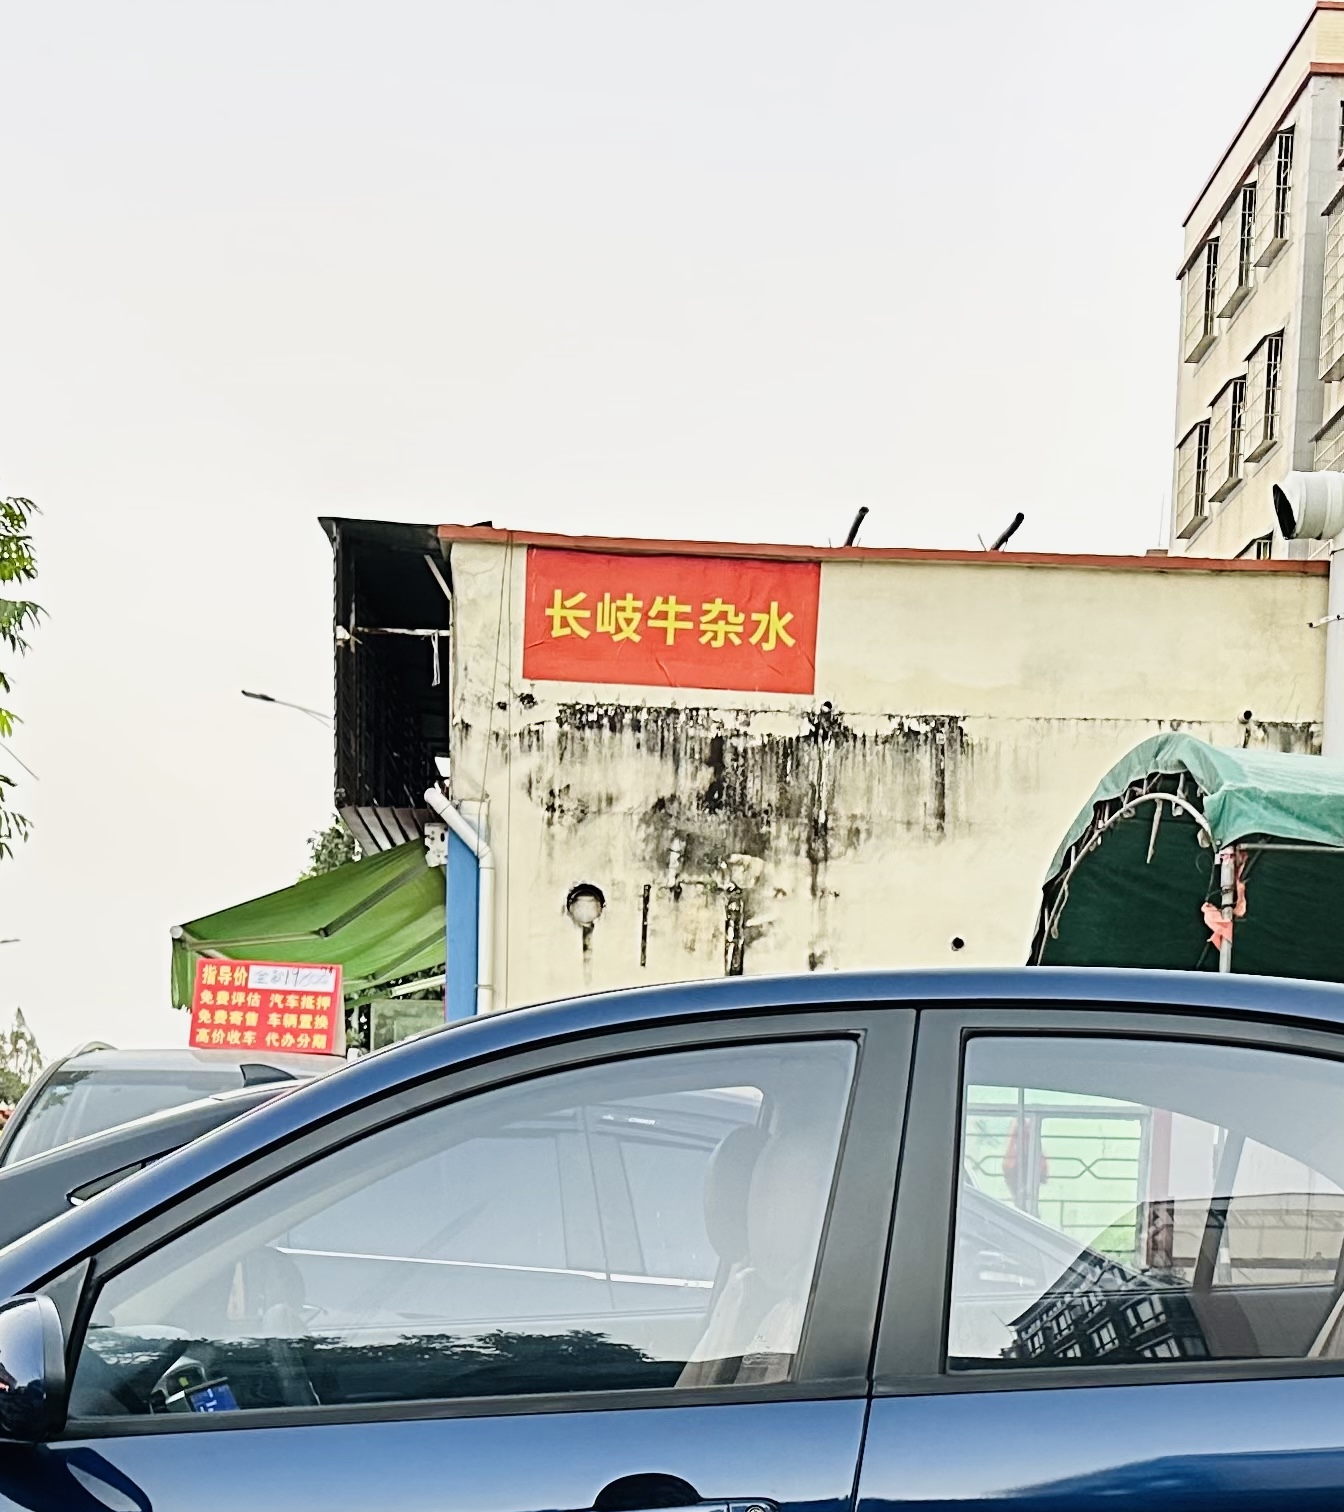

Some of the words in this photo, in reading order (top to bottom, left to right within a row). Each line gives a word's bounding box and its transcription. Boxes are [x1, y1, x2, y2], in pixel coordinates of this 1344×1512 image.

[545, 589, 796, 652] 长岐牛杂水
[202, 965, 247, 987] 指导价
[200, 989, 261, 1008] 免费评估
[269, 993, 331, 1011] 汽车抵押
[198, 1008, 258, 1027] 免费寄售
[267, 1013, 328, 1030] 车辆置换
[195, 1028, 256, 1046] 高价收车
[265, 1032, 327, 1049] 代办分期
